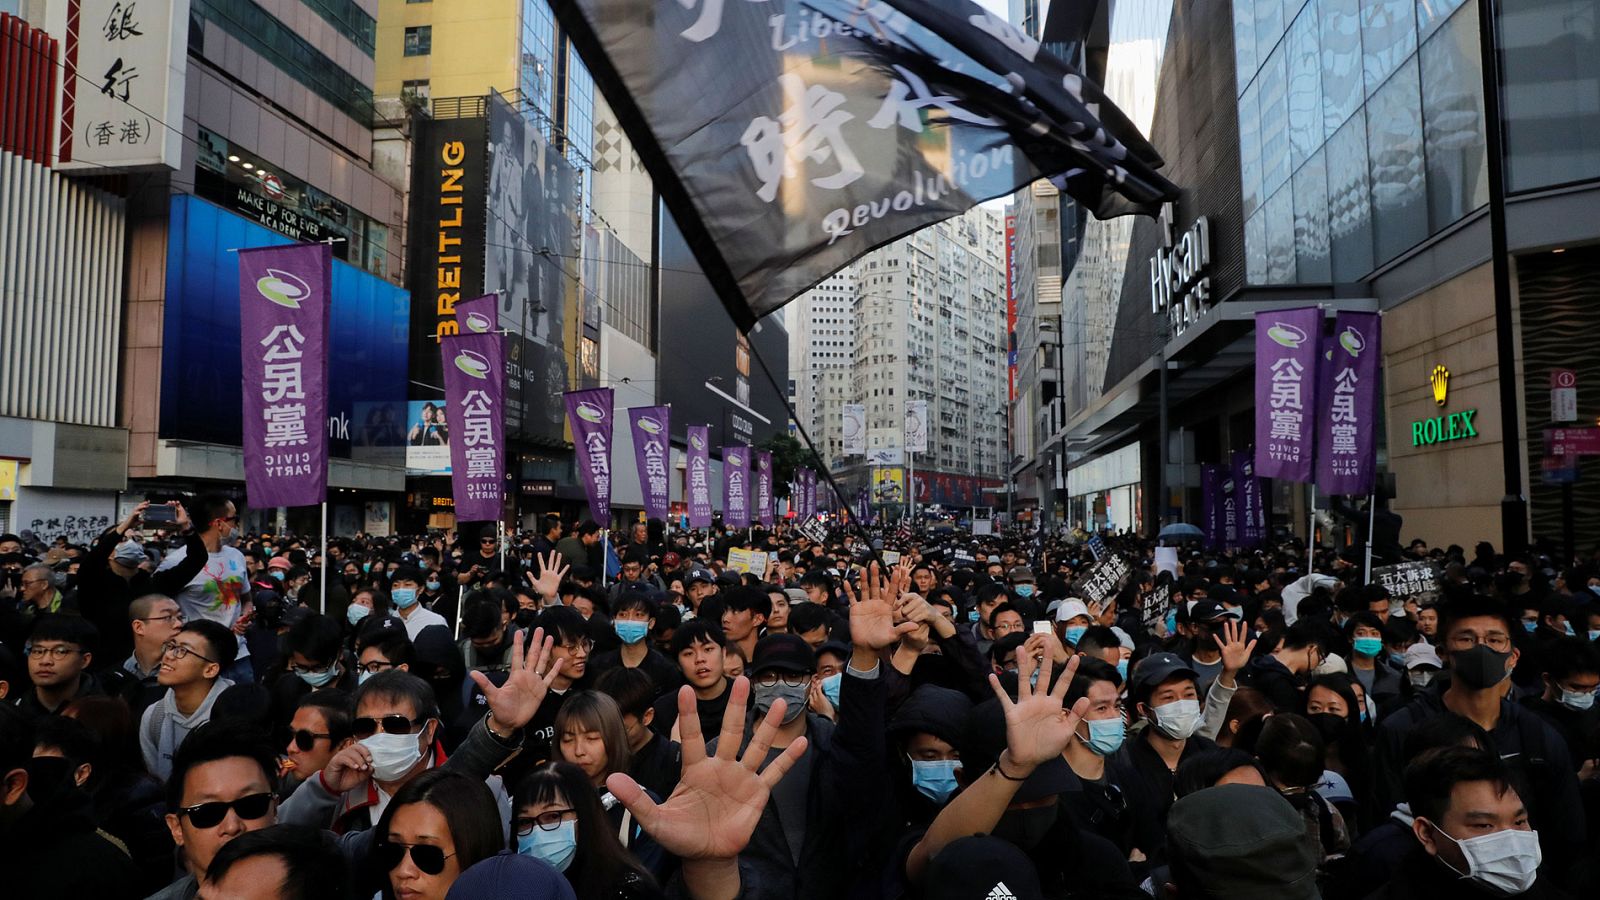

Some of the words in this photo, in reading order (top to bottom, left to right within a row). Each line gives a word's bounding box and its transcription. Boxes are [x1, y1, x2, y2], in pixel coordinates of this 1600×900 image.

[101, 2, 143, 102] 銀行
[85, 118, 151, 148] (香港)
[237, 188, 264, 211] MAKE
[266, 201, 278, 216] UP
[281, 208, 297, 226] FOR
[260, 213, 301, 240] ACADEMY
[436, 140, 466, 344] BREITLING
[1149, 214, 1211, 318] Hysan
[1412, 408, 1478, 446] ROLEX
[432, 497, 455, 507] BREITL
[1081, 553, 1122, 596] 五大訴求
[1380, 567, 1434, 586] 五大訴求
